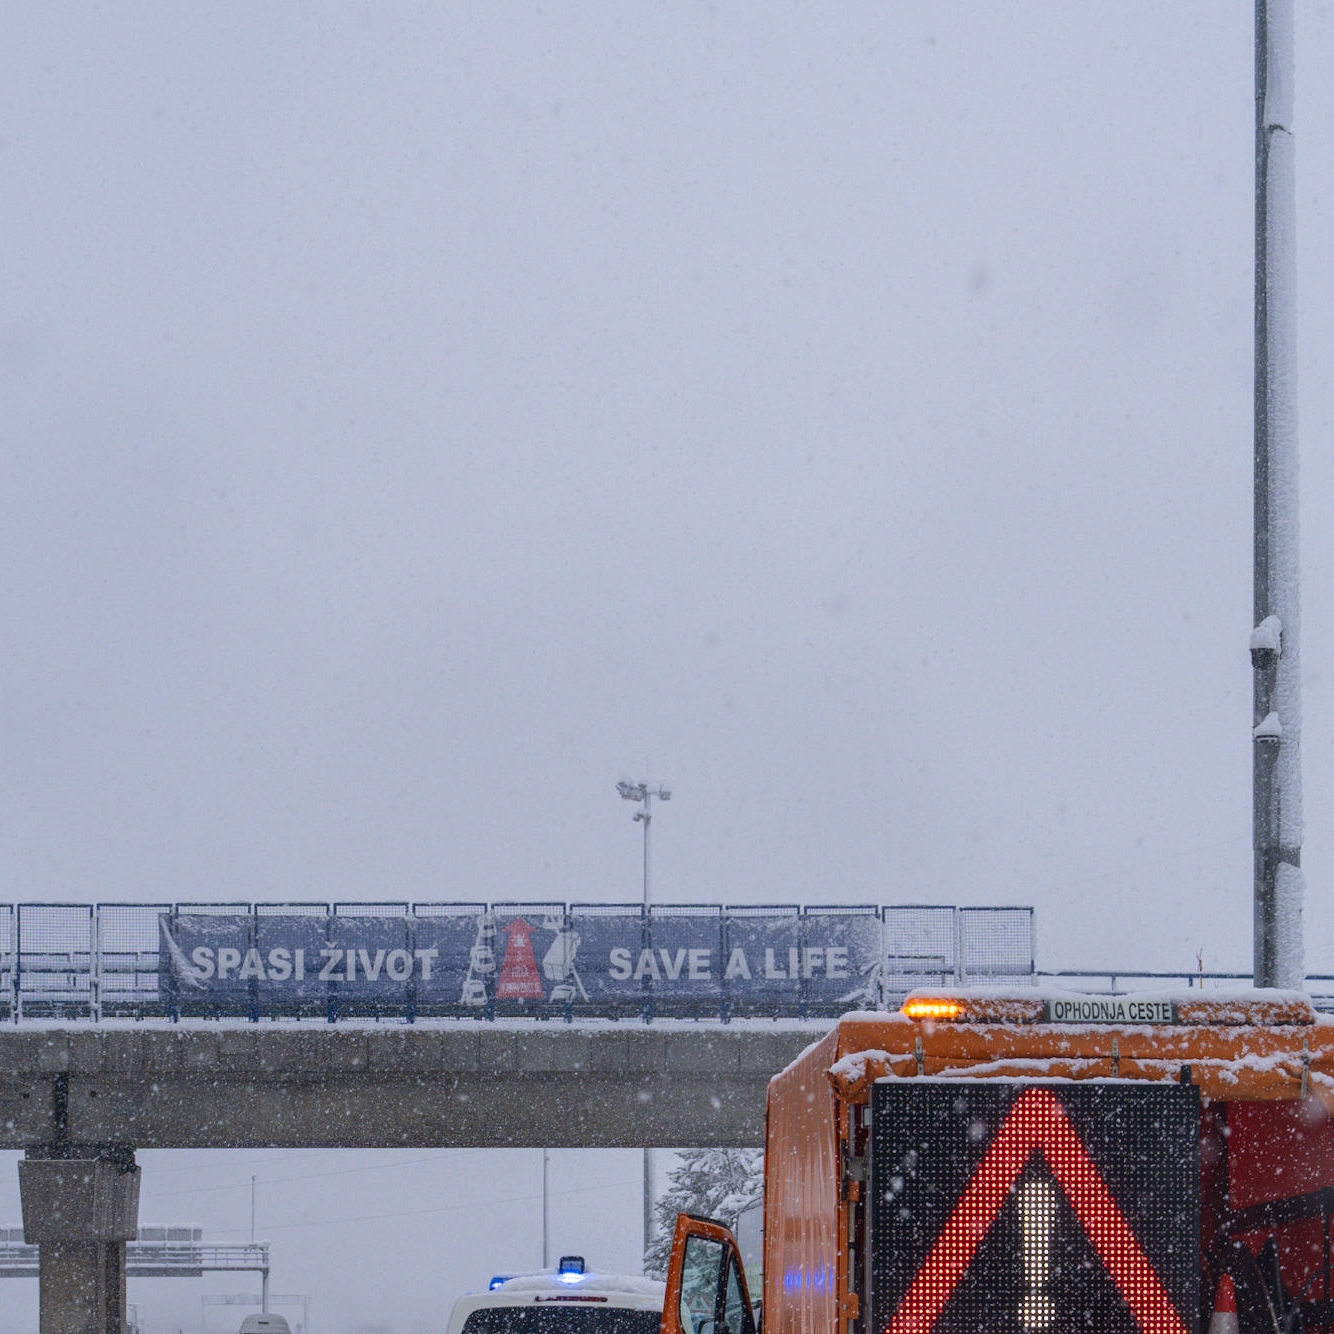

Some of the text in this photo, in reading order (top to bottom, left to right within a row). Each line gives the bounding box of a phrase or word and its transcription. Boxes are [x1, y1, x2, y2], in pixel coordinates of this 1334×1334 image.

[191, 942, 439, 981] SPASI ŽIVOT
[608, 947, 849, 980] SAVE A LIFE
[1054, 1001, 1170, 1020] OPHODNJA CESTE
